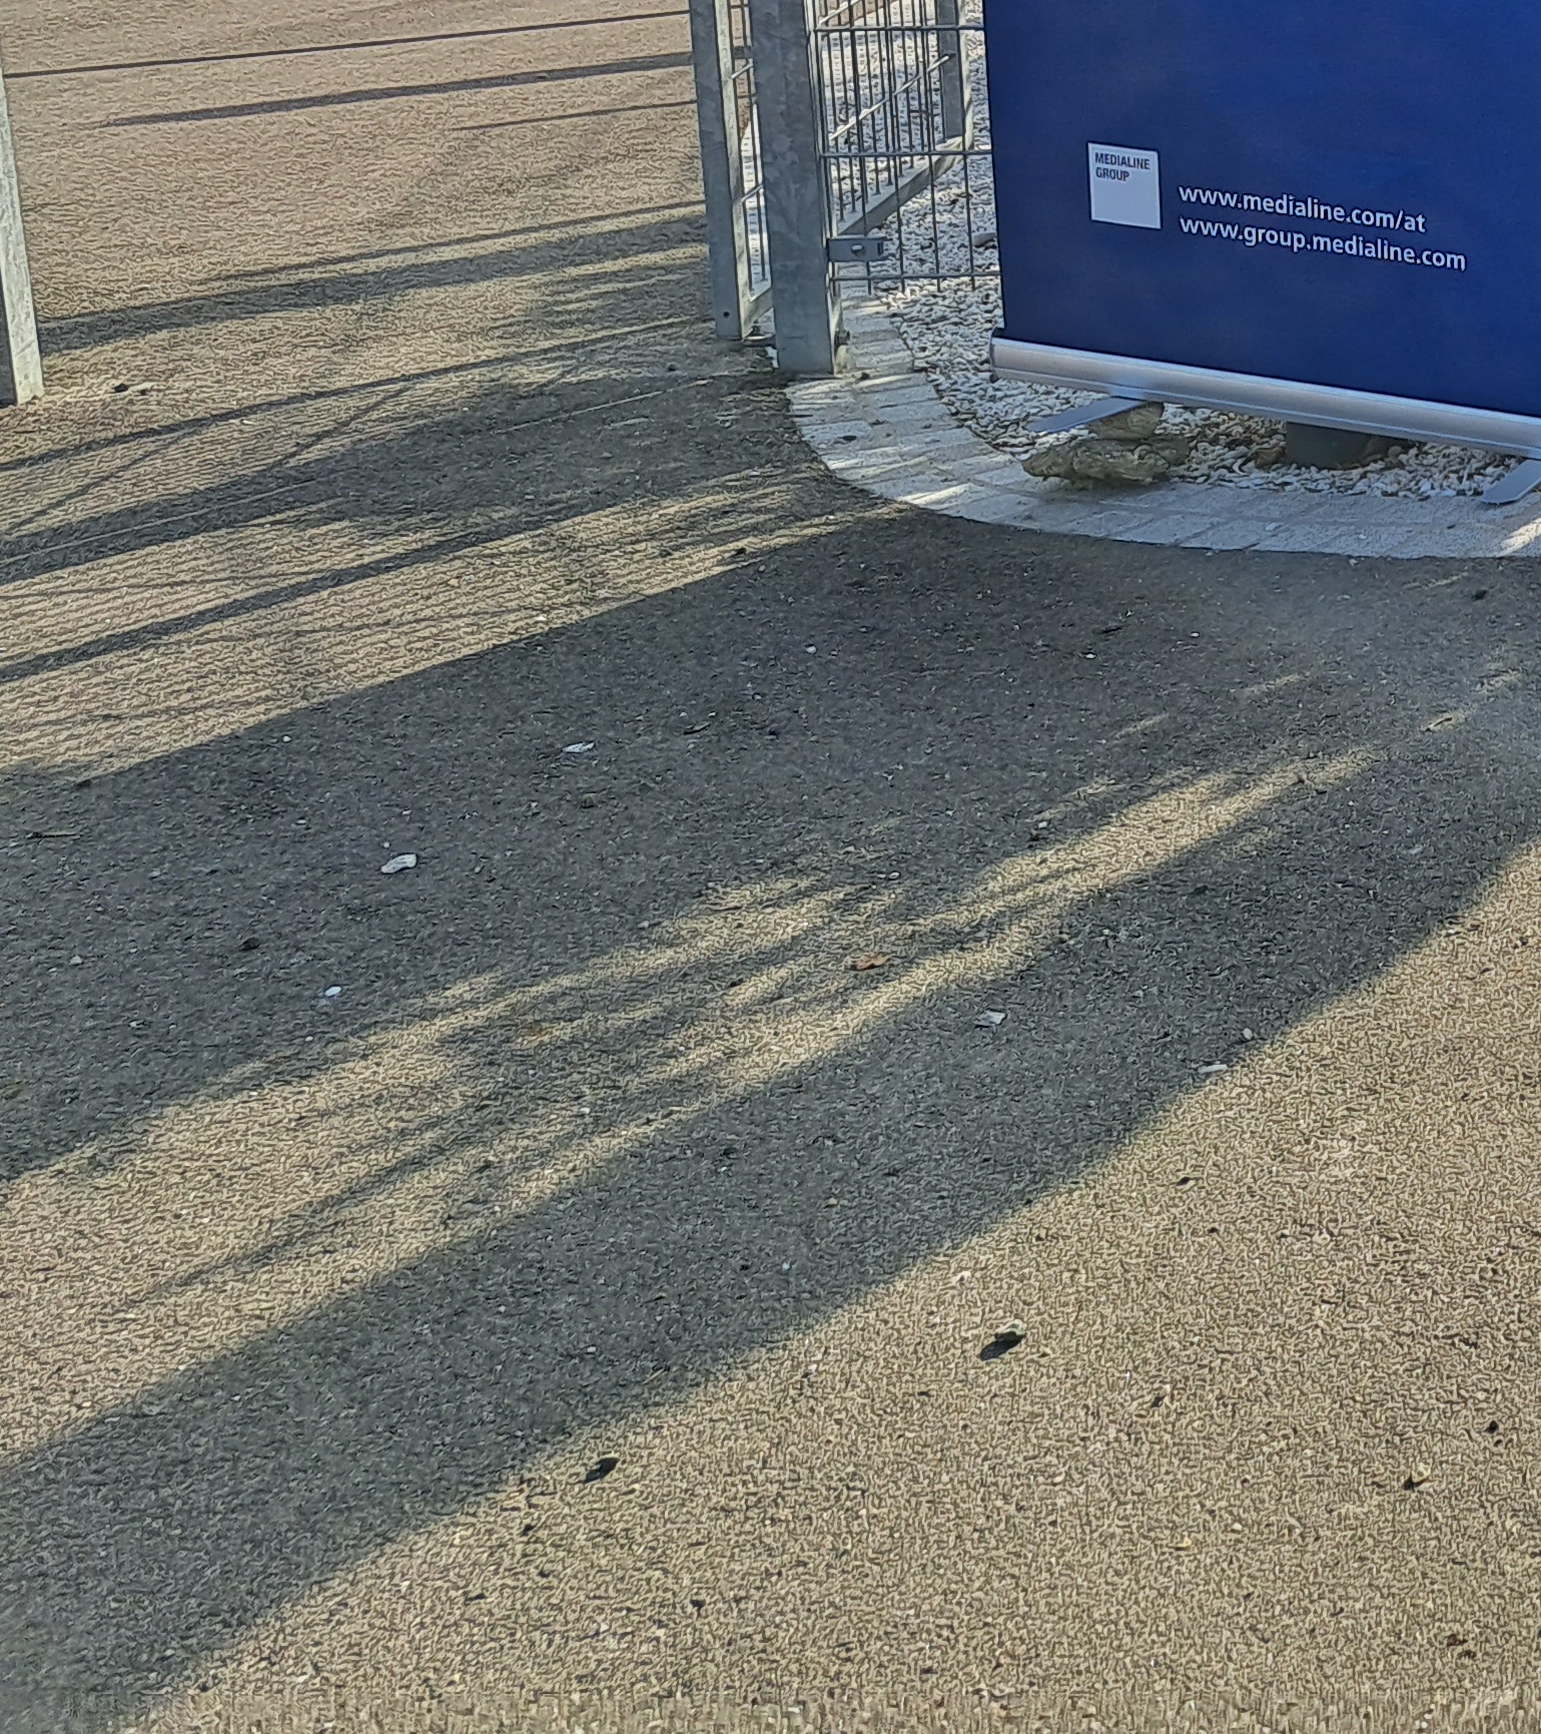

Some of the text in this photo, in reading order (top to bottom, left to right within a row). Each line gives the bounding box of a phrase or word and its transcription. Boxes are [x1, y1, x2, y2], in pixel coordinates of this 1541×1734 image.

[1094, 152, 1151, 170] MEDIALINE
[1095, 167, 1130, 182] GROUP
[1178, 184, 1427, 234] www.medialine.com/at
[1179, 215, 1467, 272] www.group.medialine.com
